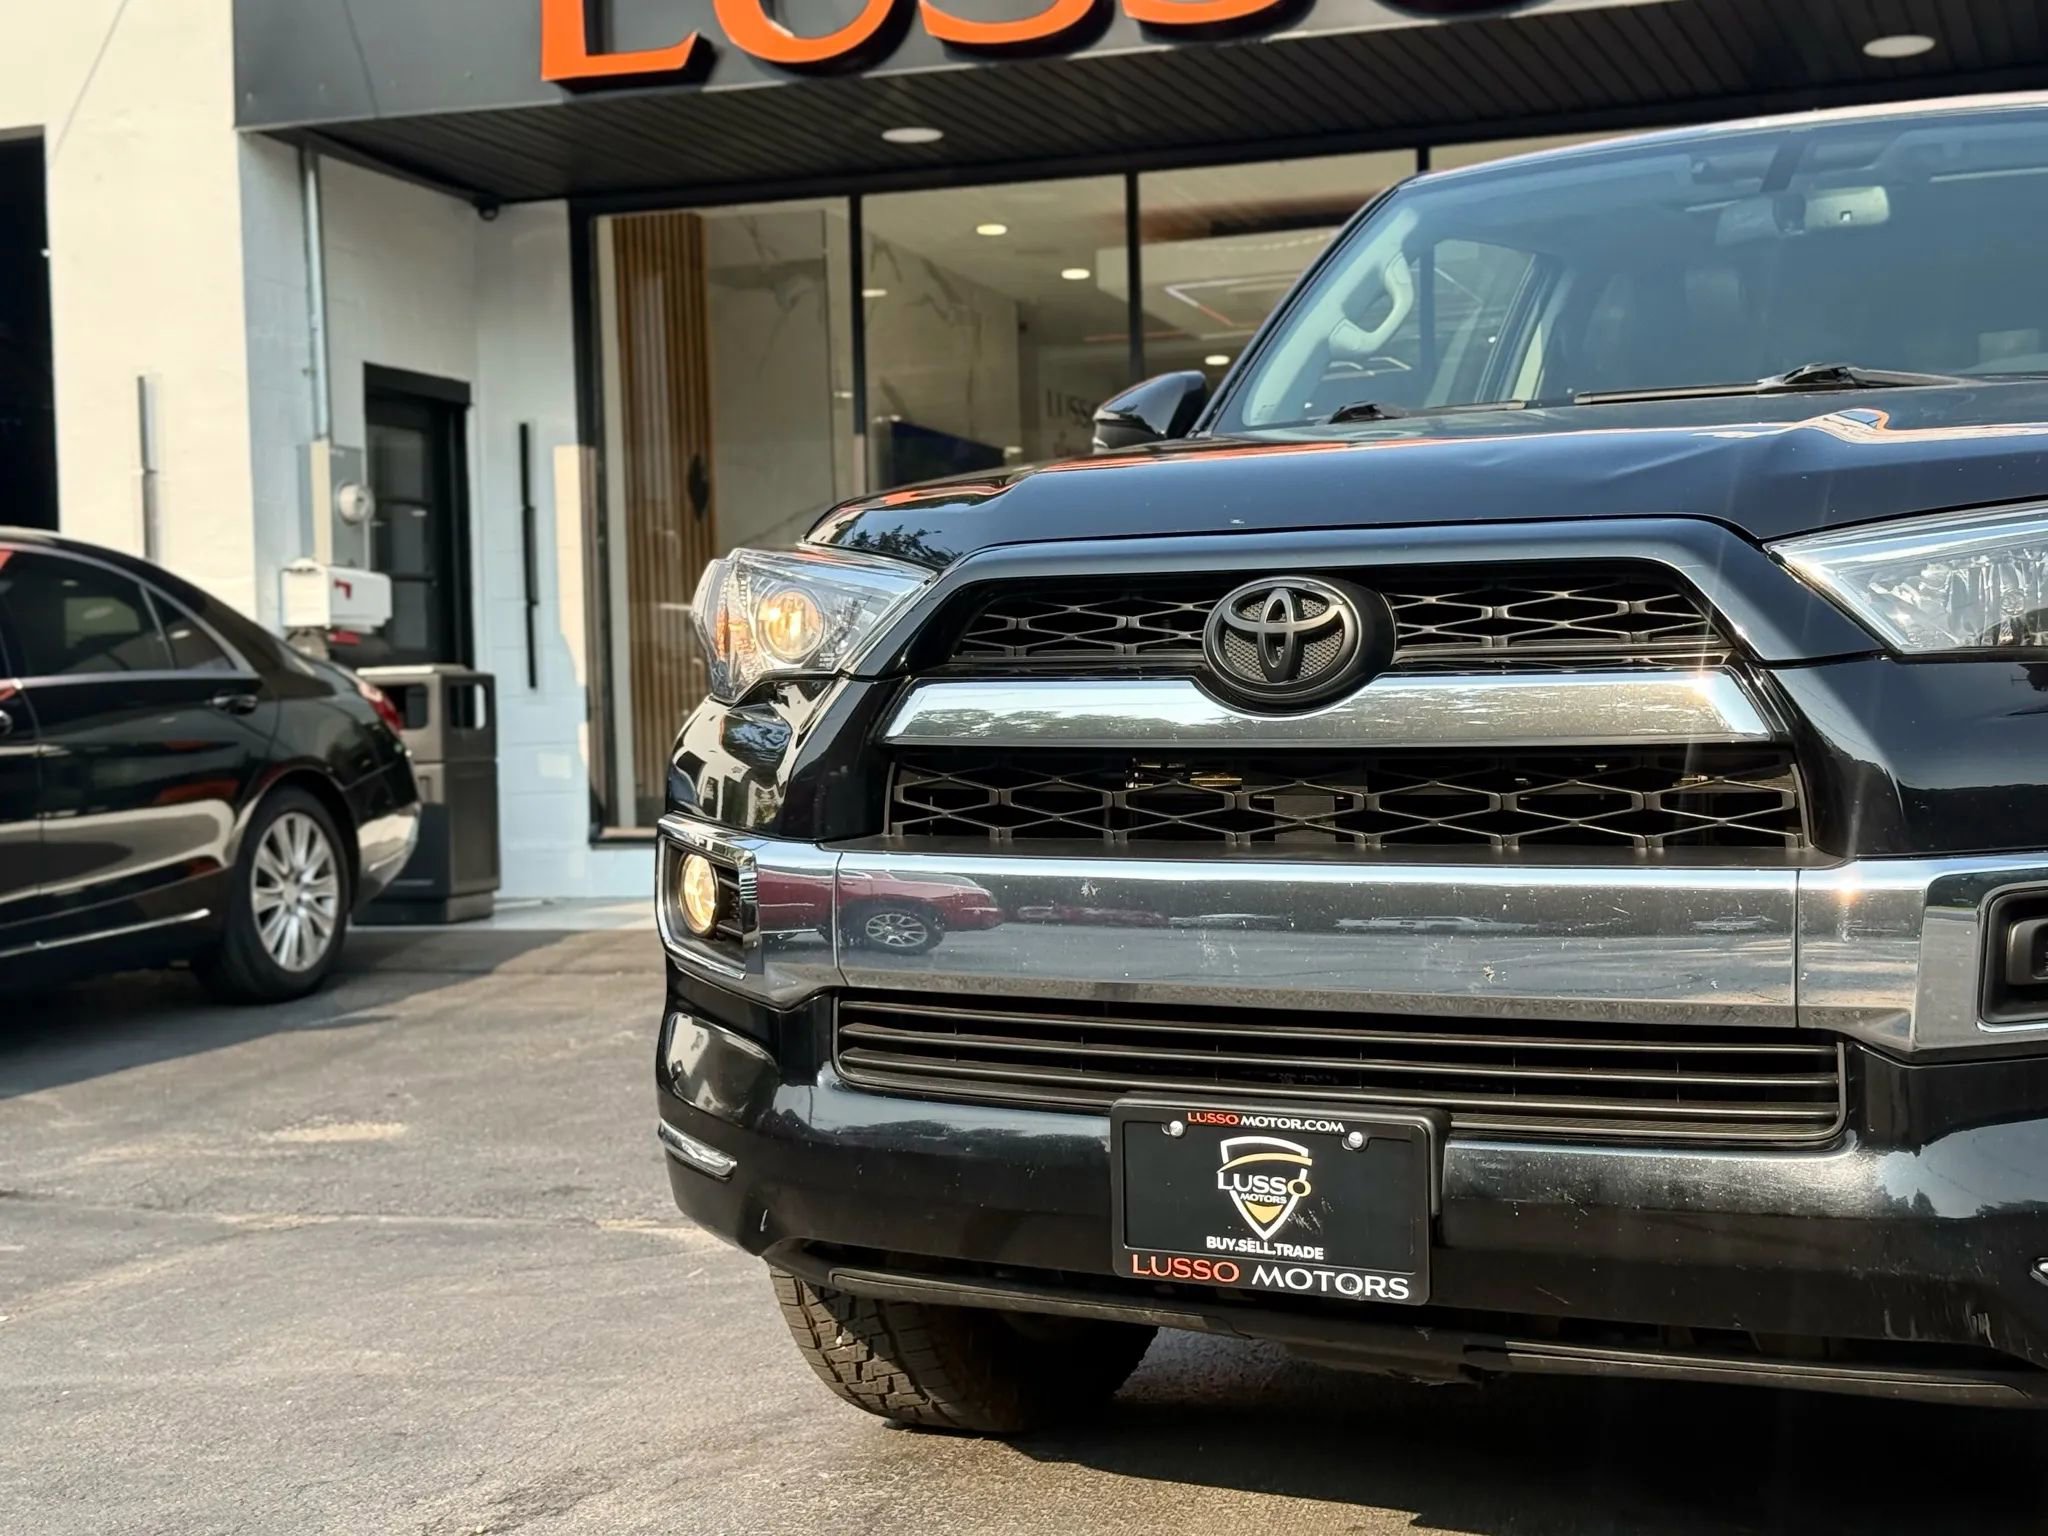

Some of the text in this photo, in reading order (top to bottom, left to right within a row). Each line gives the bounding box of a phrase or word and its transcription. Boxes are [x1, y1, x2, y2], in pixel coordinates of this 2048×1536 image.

[1187, 1112, 1345, 1133] LUSSOMOTOR.COM
[1217, 1172, 1312, 1197] LUSSO
[1240, 1192, 1287, 1205] MOTORS
[1206, 1236, 1324, 1260] BUY.SELL.TRADE
[1132, 1254, 1410, 1300] LUSSO MOTORS
